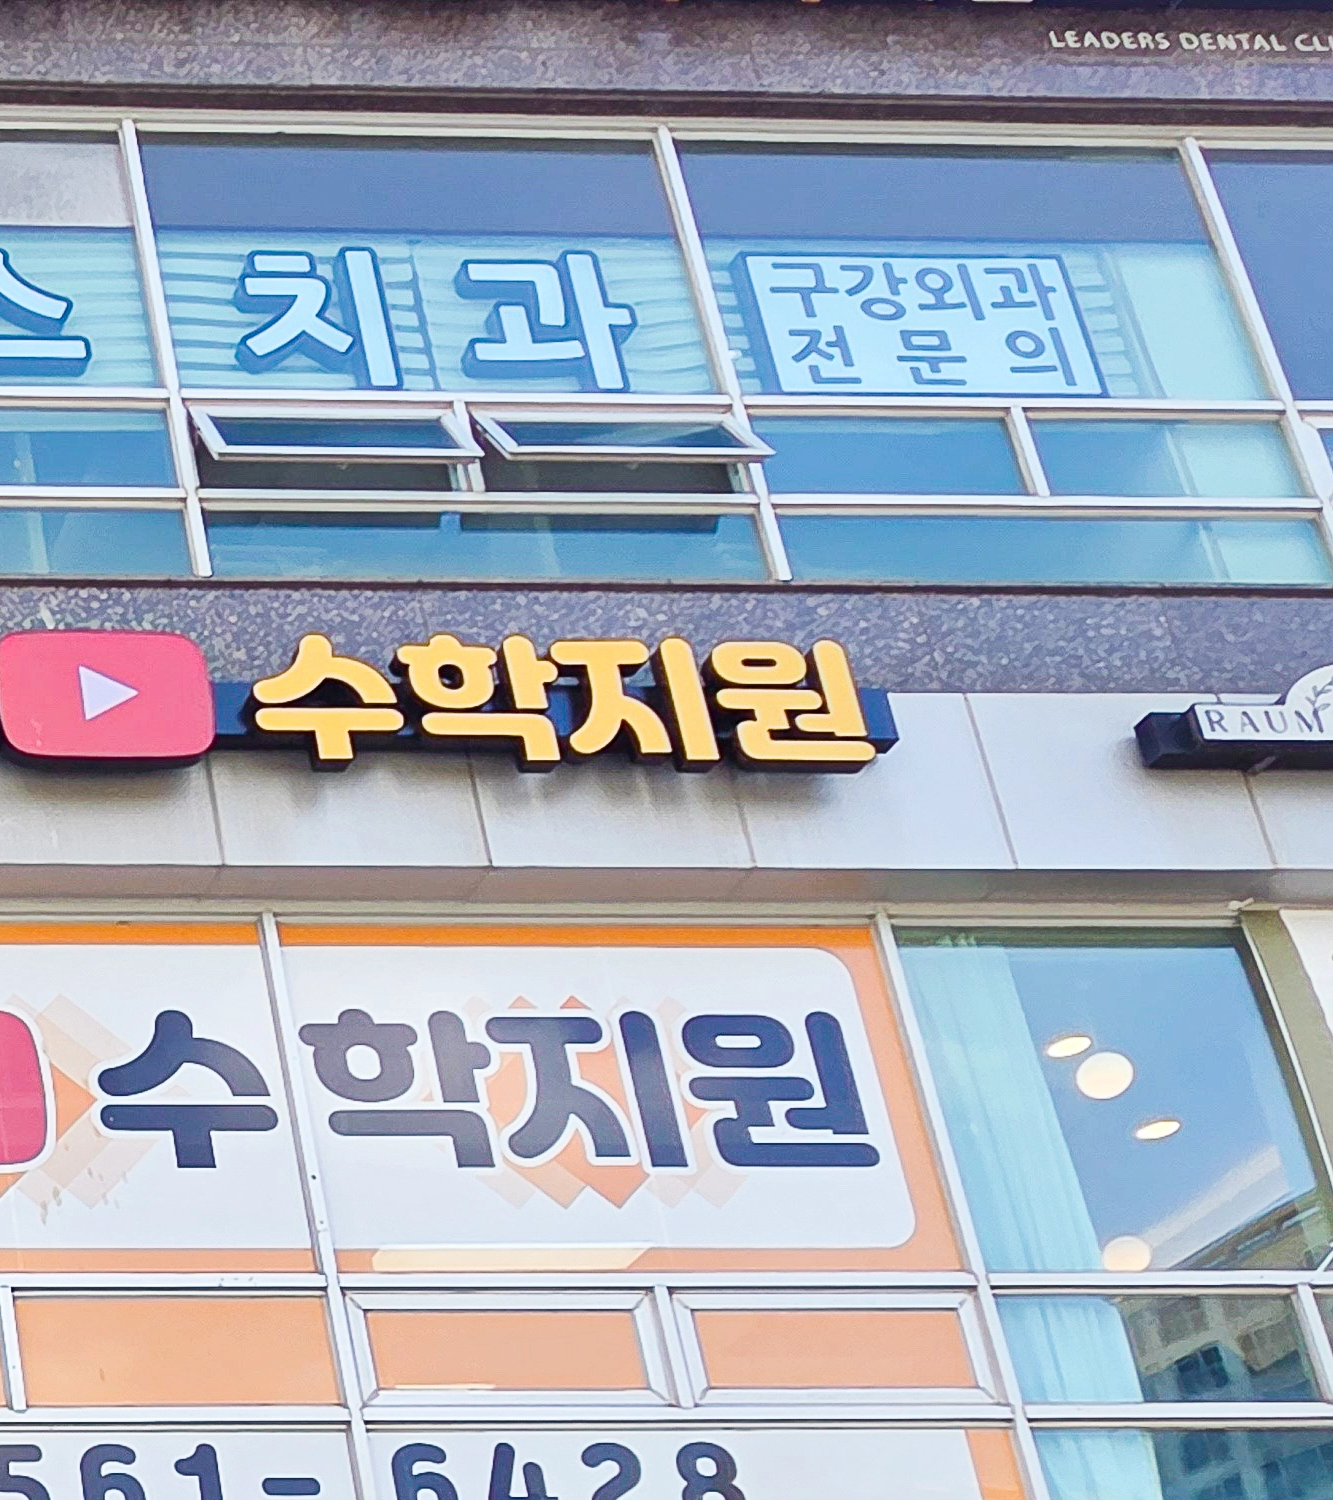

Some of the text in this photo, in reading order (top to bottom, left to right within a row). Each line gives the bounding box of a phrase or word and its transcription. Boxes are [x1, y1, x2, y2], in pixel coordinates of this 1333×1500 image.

[1049, 30, 1170, 50] LEADERS
[1178, 32, 1288, 52] DENTAL
[769, 260, 1057, 323] 구강외과
[251, 632, 879, 774] 수학지원
[96, 1008, 881, 1169] 수학지원
